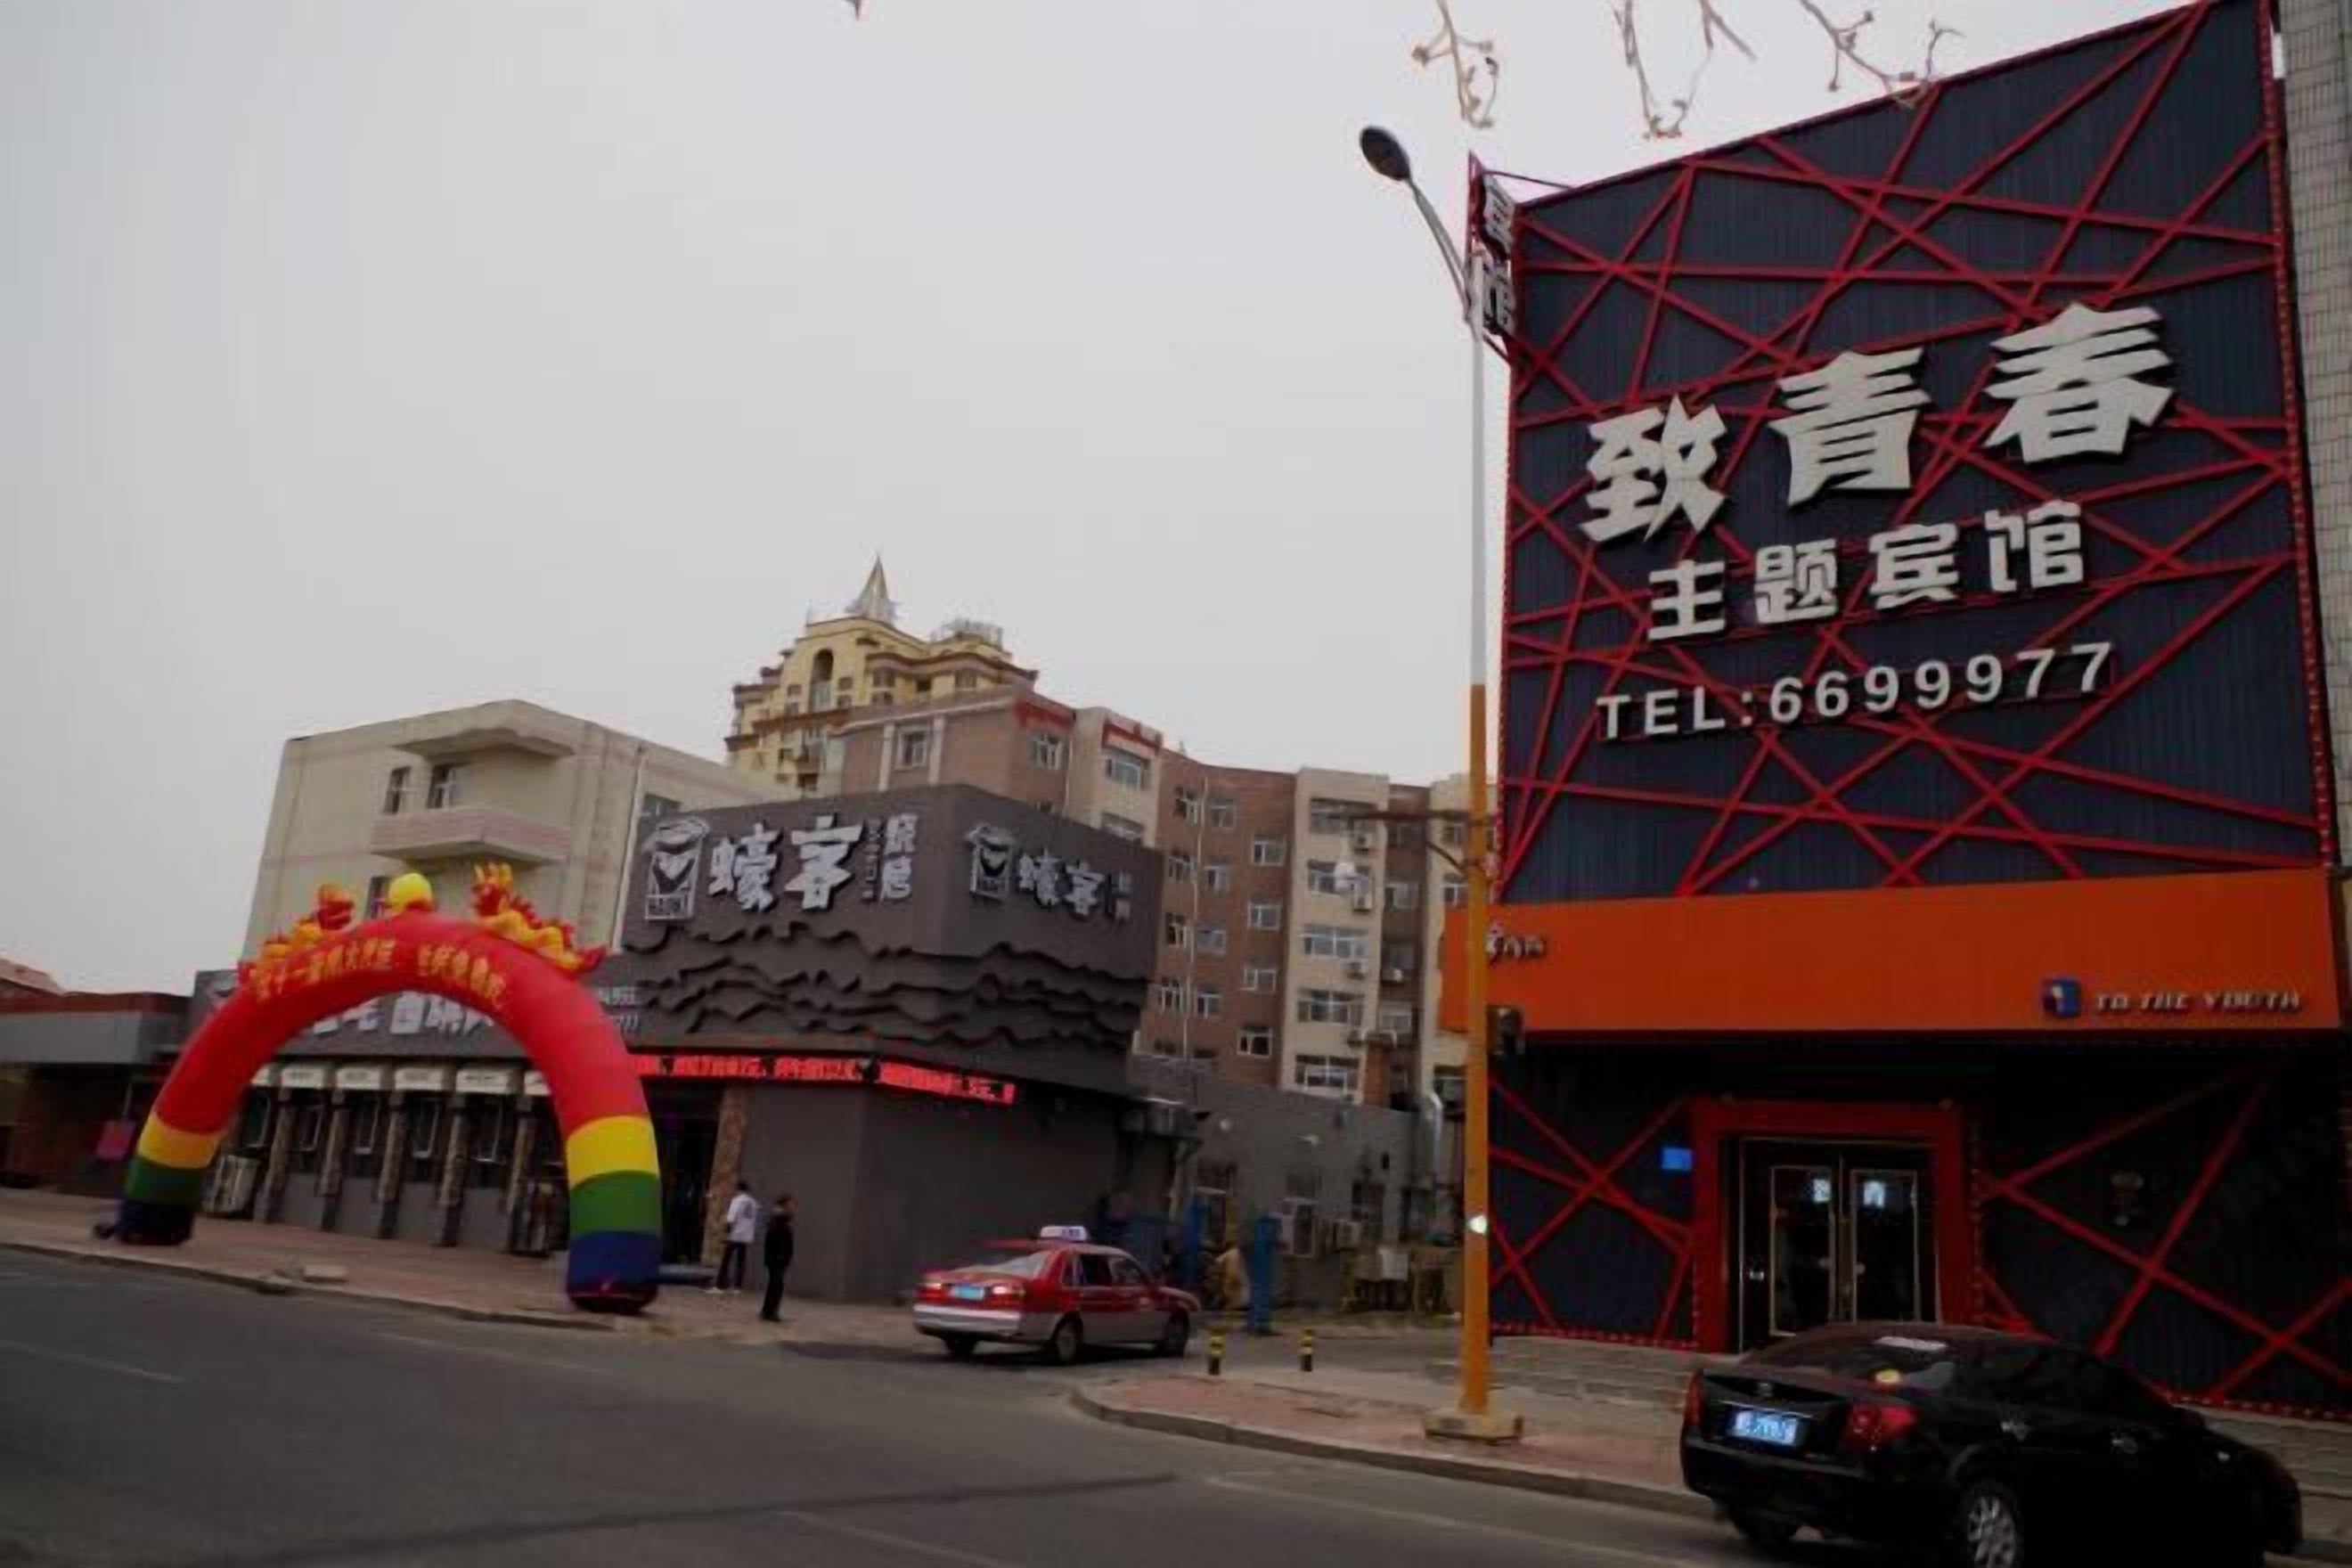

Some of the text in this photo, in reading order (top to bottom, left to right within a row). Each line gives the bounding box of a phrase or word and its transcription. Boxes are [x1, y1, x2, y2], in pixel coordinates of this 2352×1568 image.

[1578, 303, 2176, 543] 致青春
[1646, 500, 2086, 641] 主题宾馆
[1597, 641, 2112, 740] TEL:6699977
